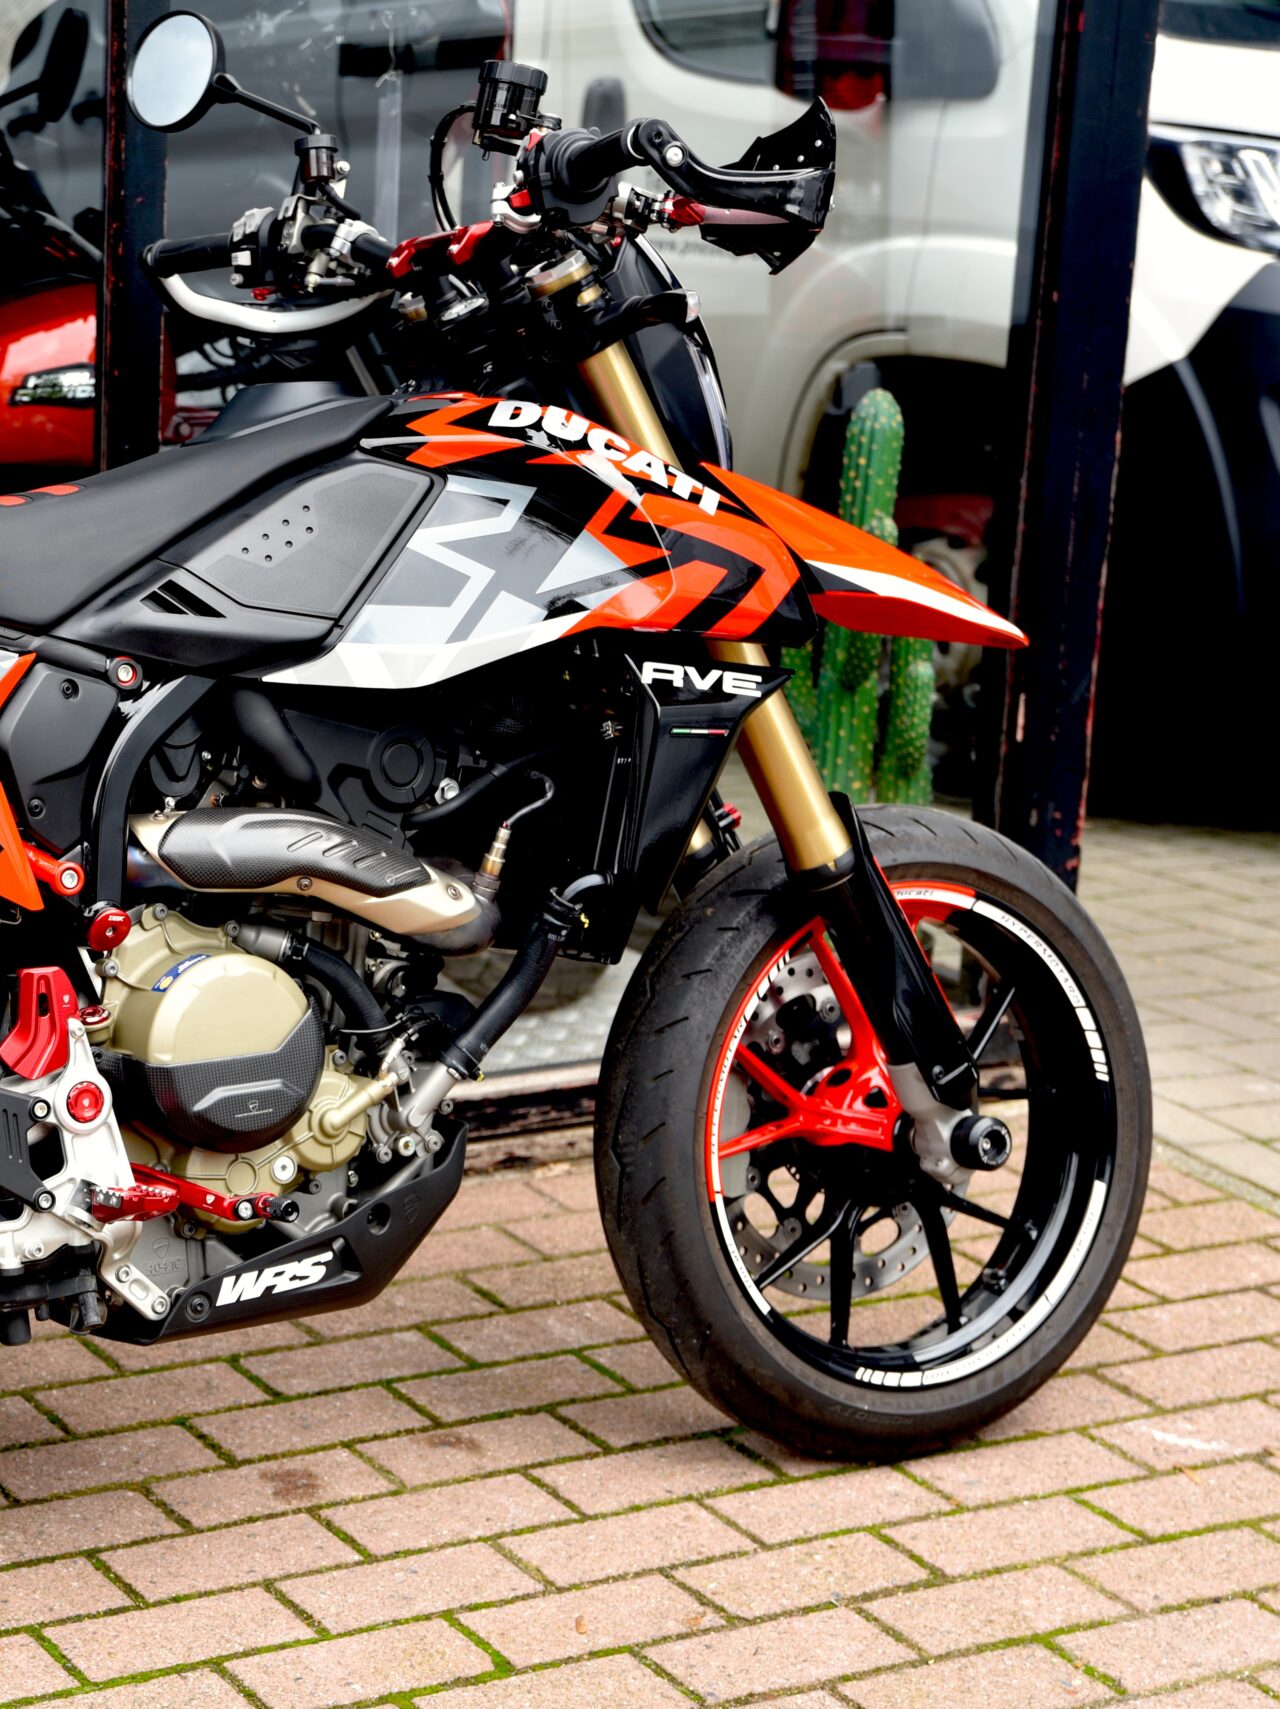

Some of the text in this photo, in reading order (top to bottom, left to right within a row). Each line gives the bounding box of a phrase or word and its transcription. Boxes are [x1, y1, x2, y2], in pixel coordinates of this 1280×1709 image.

[488, 400, 721, 516] DUCATI
[641, 661, 763, 697] RVE
[216, 1251, 333, 1306] WRS
